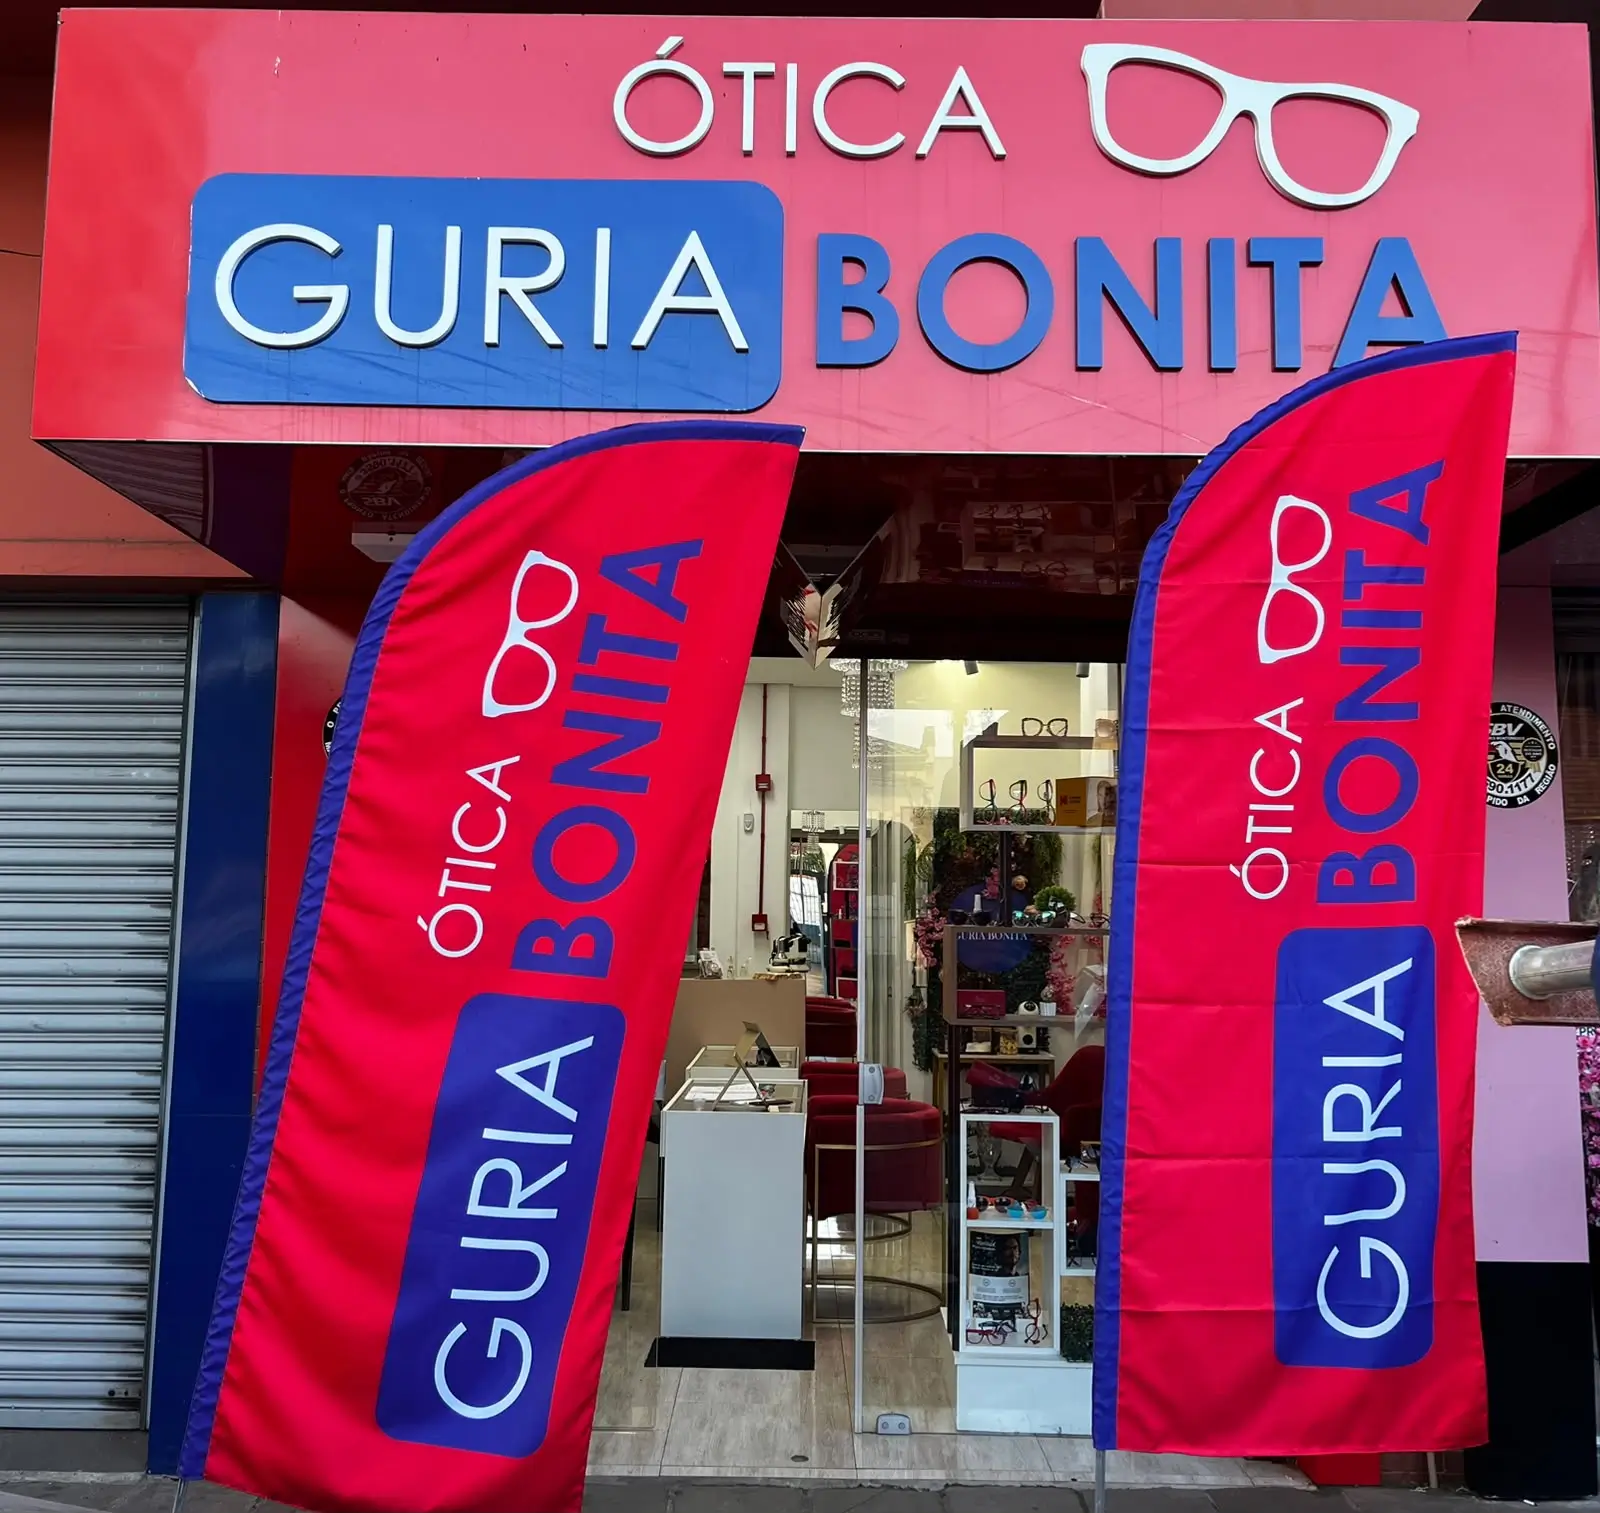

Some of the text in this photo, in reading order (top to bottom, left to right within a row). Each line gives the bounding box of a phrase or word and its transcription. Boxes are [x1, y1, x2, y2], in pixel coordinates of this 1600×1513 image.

[612, 35, 1008, 160] ÓTICA
[214, 223, 1449, 372] GURIA BONITA
[1487, 772, 1535, 795] 90.1177
[1496, 764, 1514, 774] 24
[1500, 704, 1556, 750] ATENDIMENTO
[1517, 795, 1530, 806] DA
[1534, 763, 1556, 795] REGIÃO
[417, 755, 521, 959] ÓTICA
[1229, 697, 1304, 901] ÓTICA
[958, 932, 985, 941] URIA
[1316, 460, 1444, 1340] GURIA BONITA
[434, 538, 704, 1420] GURIA BONITA
